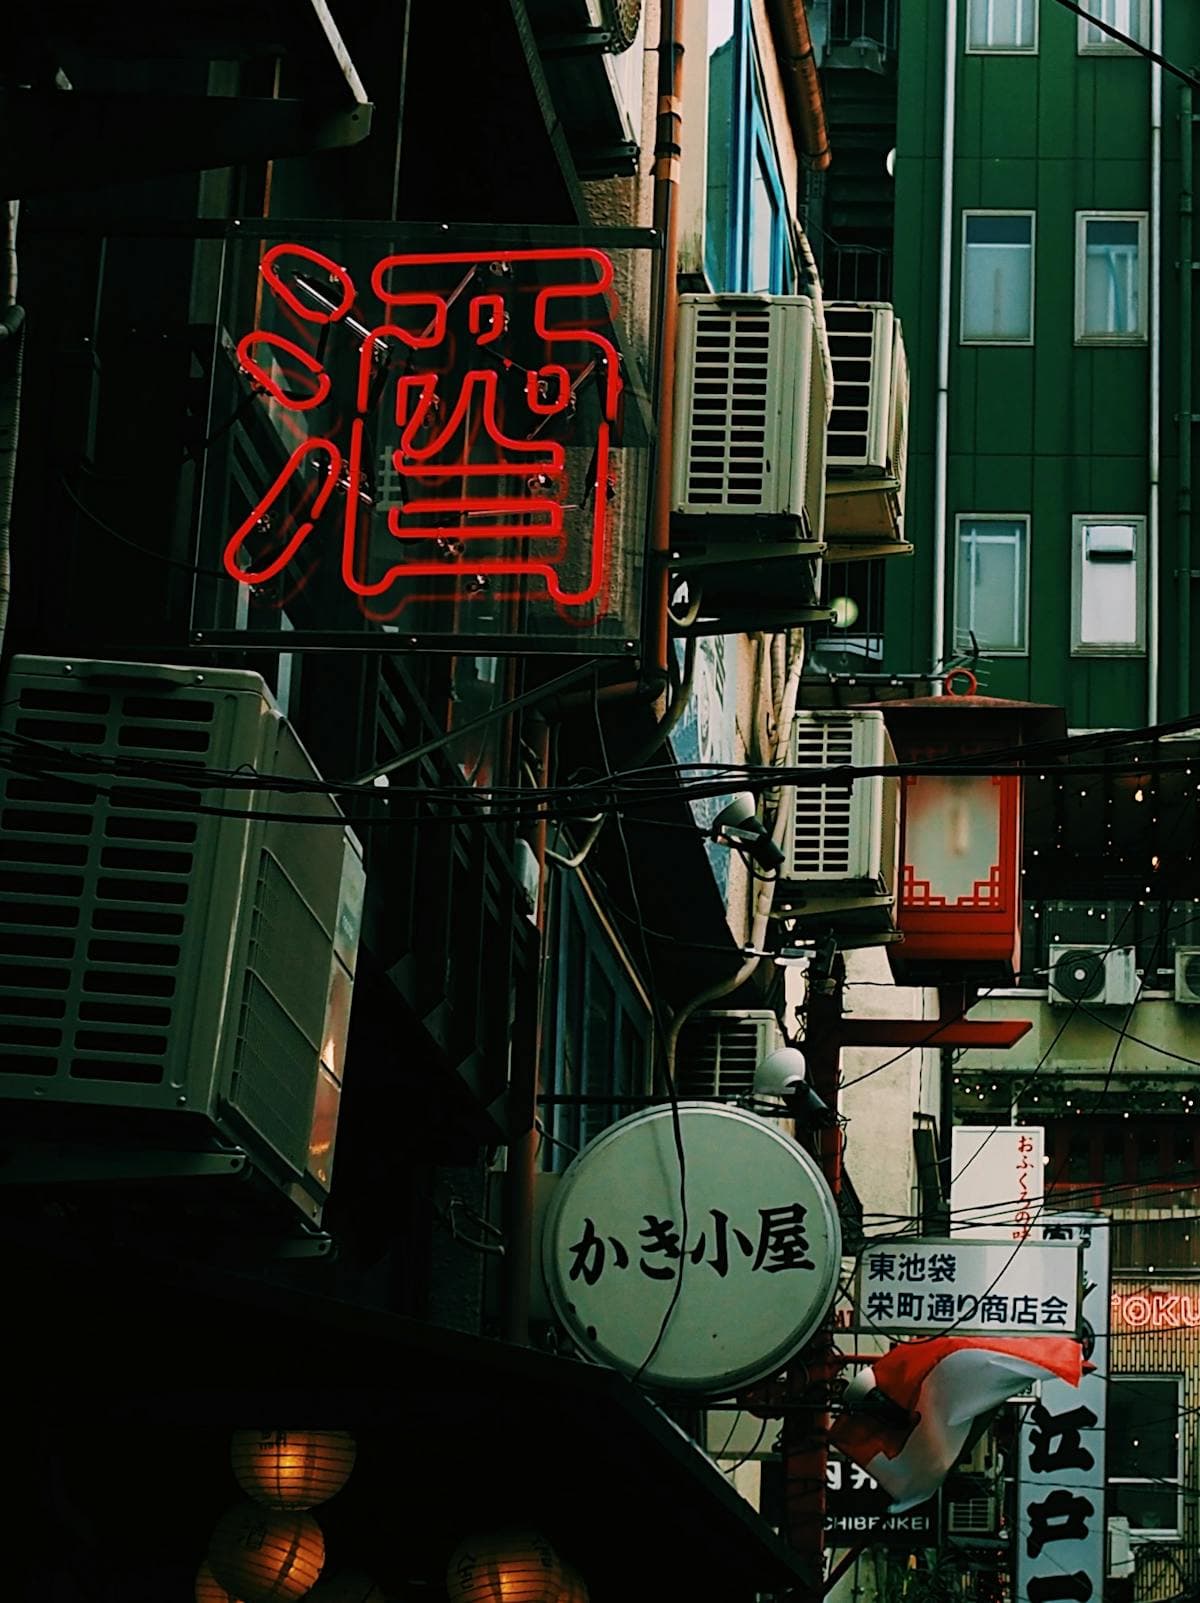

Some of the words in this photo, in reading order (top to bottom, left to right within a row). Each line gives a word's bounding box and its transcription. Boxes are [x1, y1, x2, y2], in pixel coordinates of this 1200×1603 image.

[224, 244, 623, 605] 酒
[569, 1203, 816, 1286] かき小屋
[868, 1252, 956, 1283] 東池袋
[867, 1291, 1069, 1325] 栄町通り商店会
